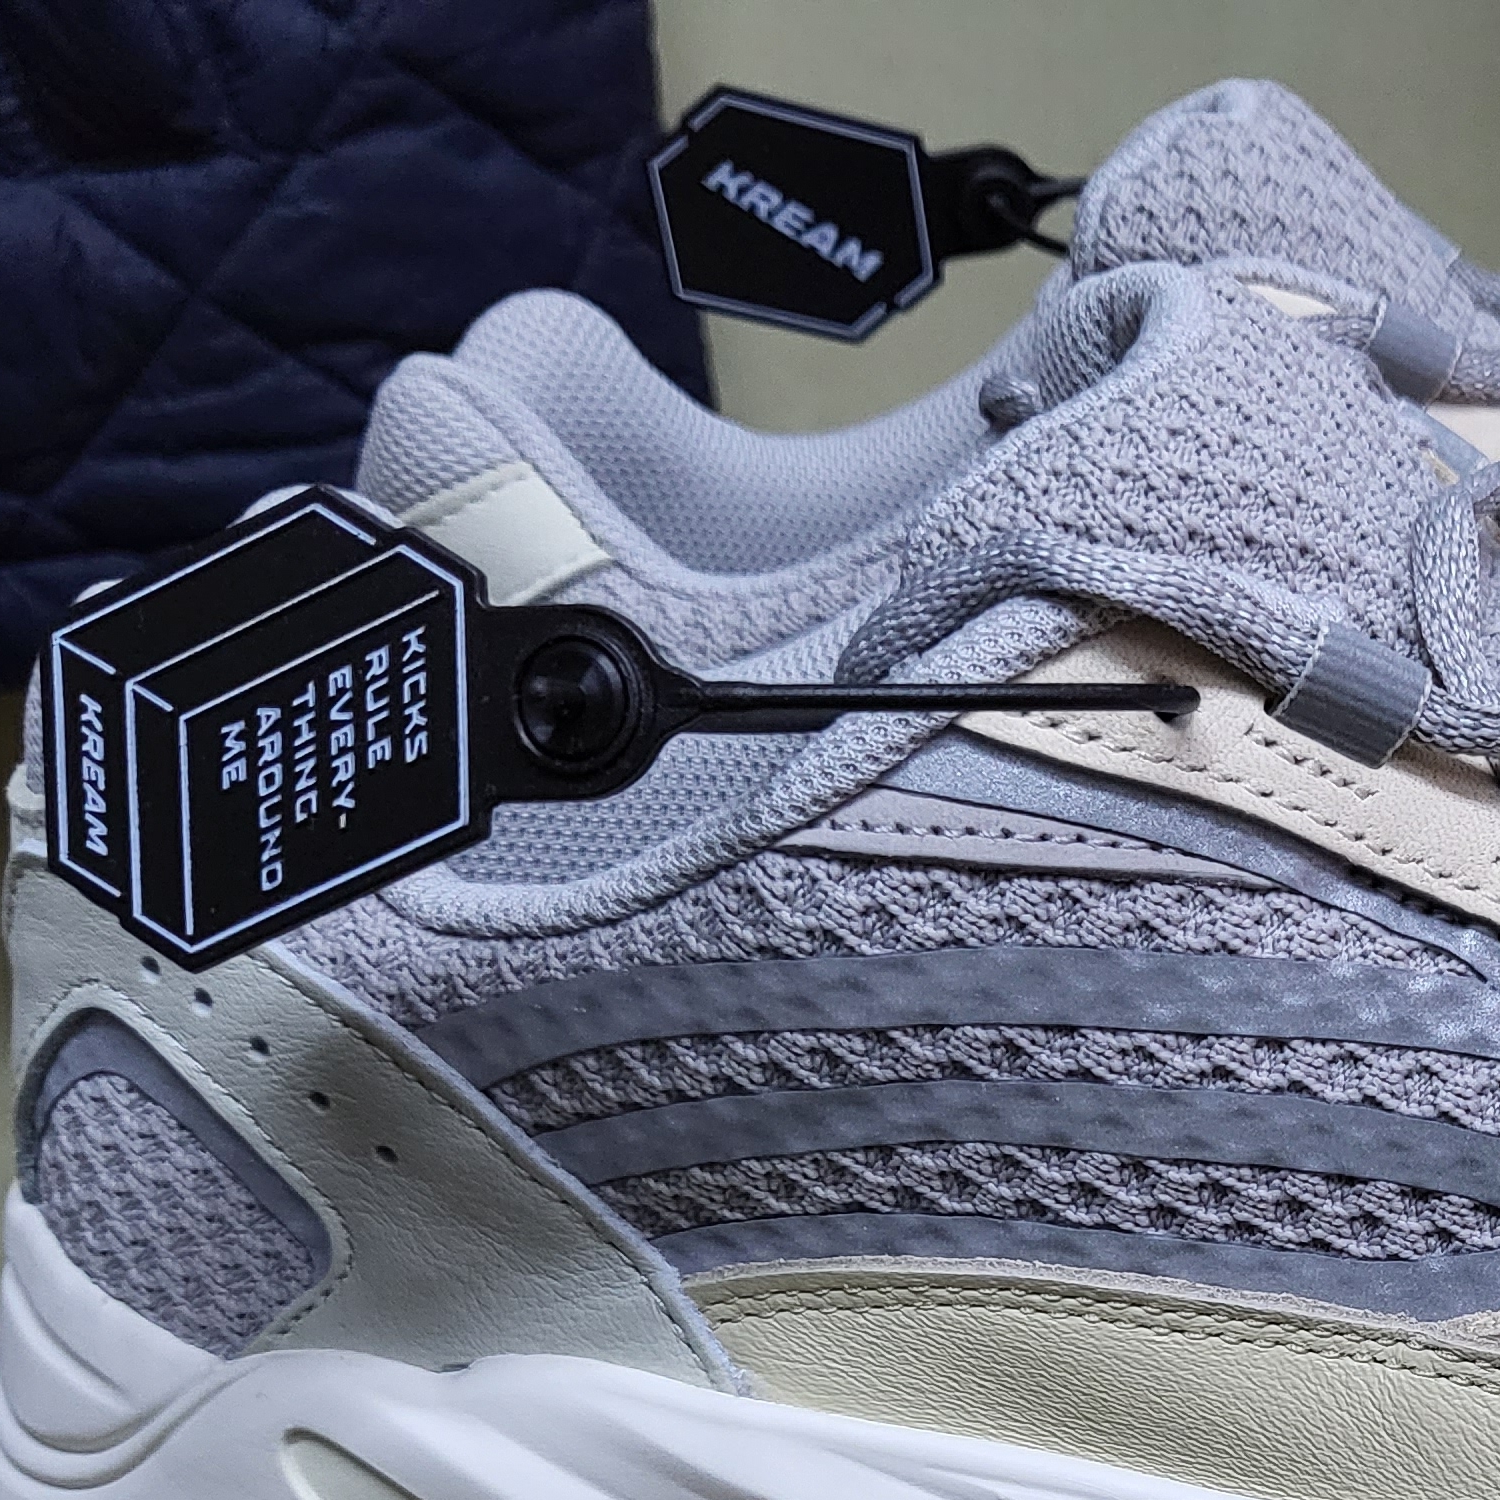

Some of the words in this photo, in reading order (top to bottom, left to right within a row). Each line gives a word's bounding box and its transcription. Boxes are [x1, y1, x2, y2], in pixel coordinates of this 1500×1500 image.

[702, 161, 883, 283] KREAM
[220, 720, 248, 791] ME
[291, 680, 318, 823] THING
[328, 664, 356, 829] EVERY-
[364, 644, 392, 769] RULE
[401, 625, 428, 763] KICKS
[79, 693, 109, 857] KREAM
[256, 707, 284, 892] AROUND
